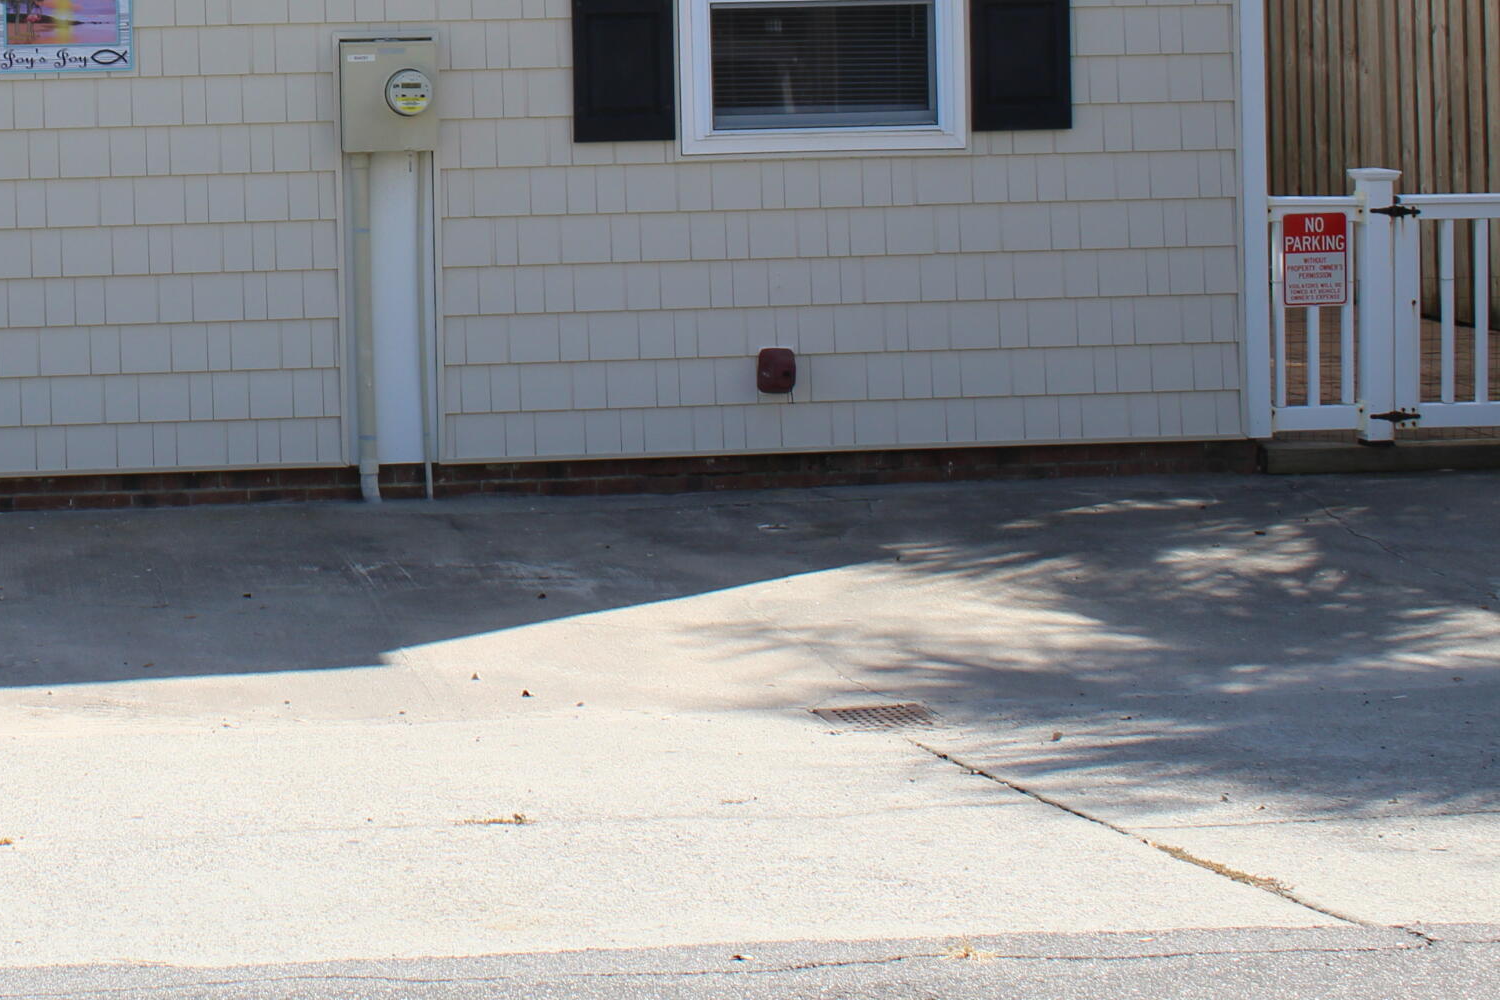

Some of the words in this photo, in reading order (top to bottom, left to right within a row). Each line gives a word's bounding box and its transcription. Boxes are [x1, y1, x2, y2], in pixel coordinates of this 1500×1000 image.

[0, 47, 46, 70] Joy's
[53, 47, 89, 70] Joy
[1305, 217, 1324, 233] NO
[1285, 235, 1344, 251] PARKING
